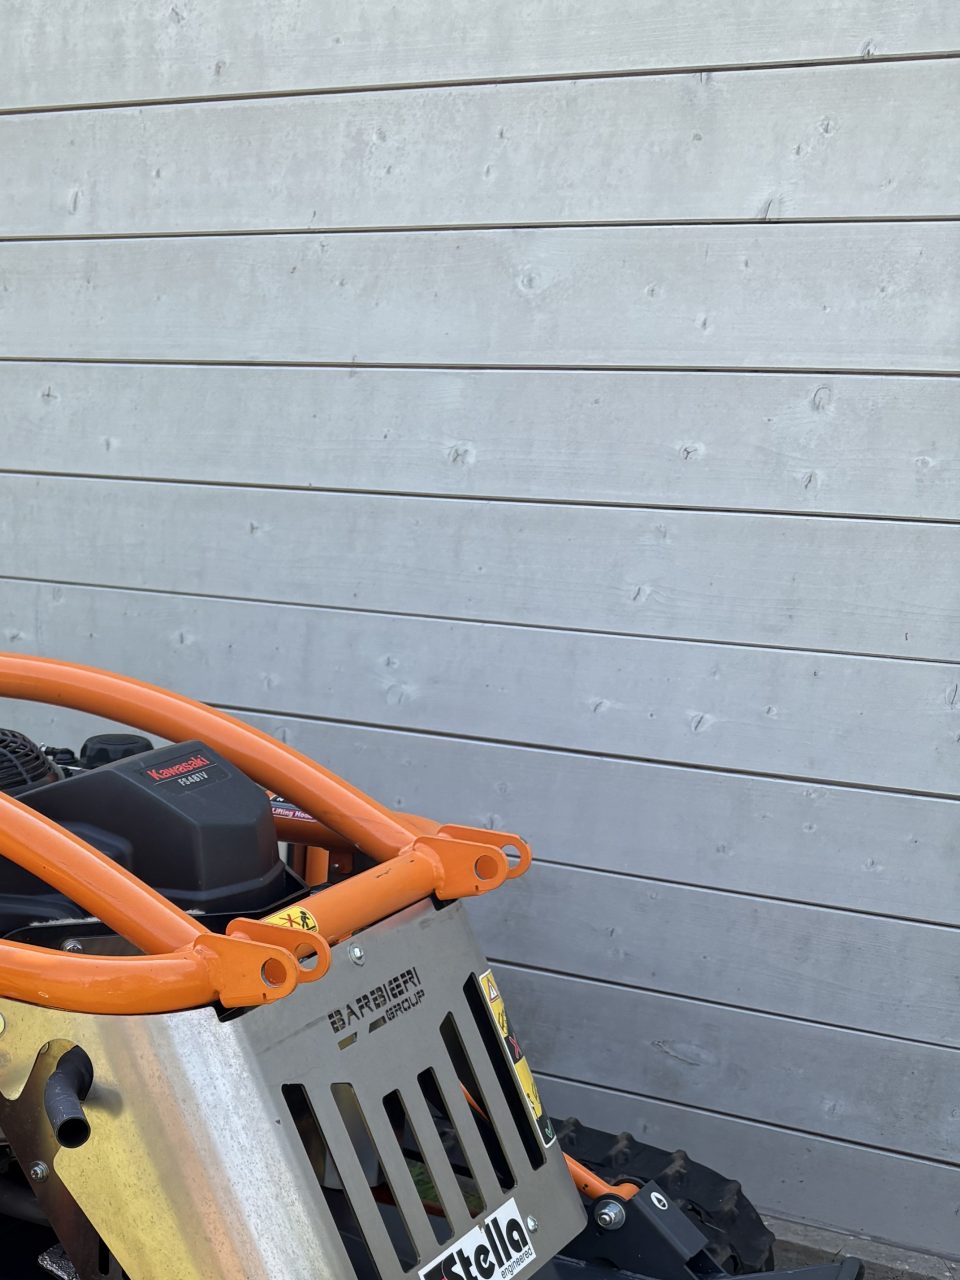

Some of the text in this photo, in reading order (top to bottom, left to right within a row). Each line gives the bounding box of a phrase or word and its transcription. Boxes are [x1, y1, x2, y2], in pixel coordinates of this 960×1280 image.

[146, 754, 210, 781] Kawasaki
[272, 807, 293, 817] Lifting
[327, 966, 421, 1034] BARBIERI
[385, 989, 425, 1021] GROUP
[501, 1247, 533, 1279] engineered
